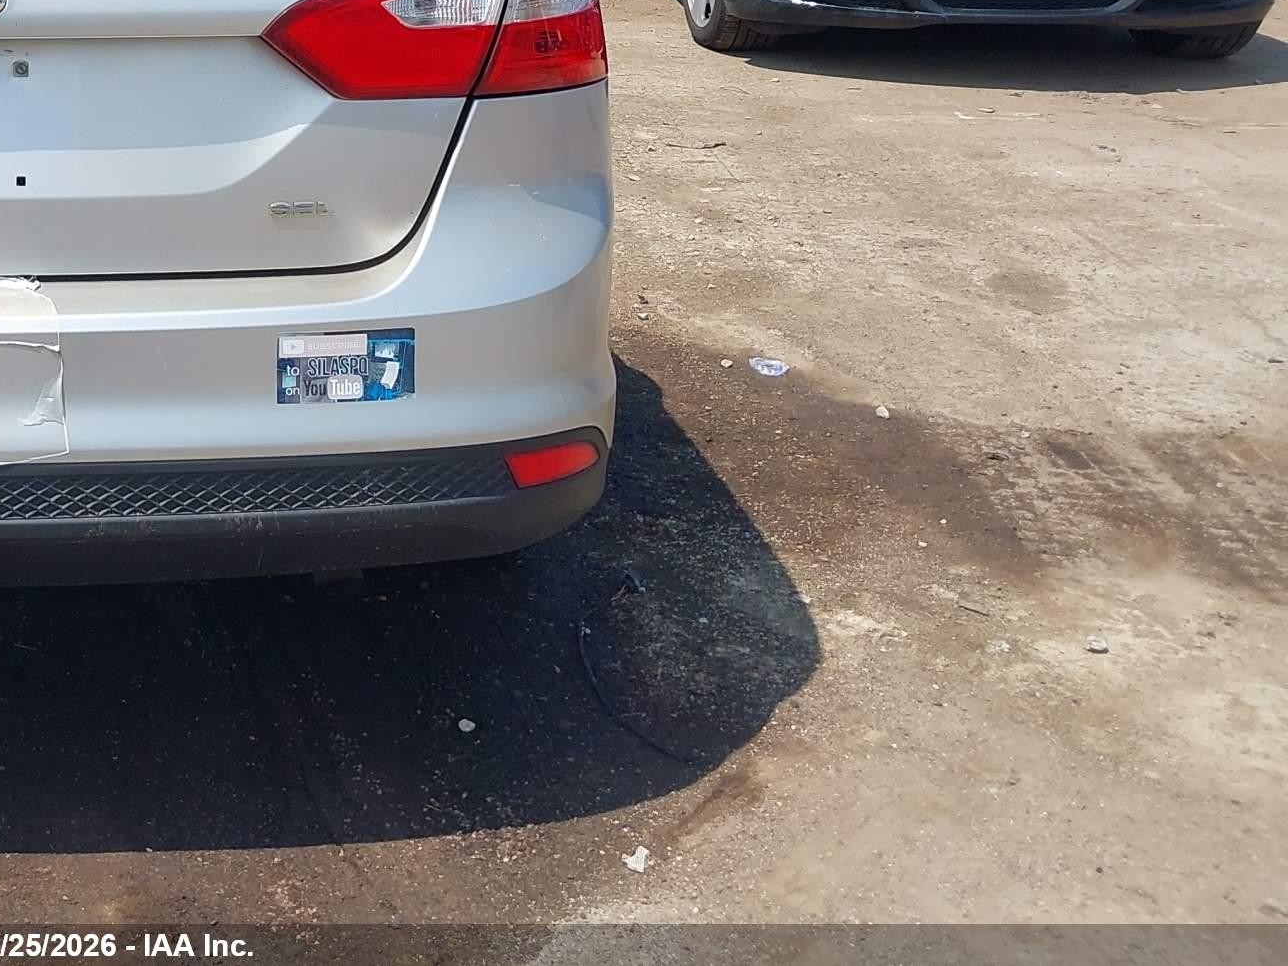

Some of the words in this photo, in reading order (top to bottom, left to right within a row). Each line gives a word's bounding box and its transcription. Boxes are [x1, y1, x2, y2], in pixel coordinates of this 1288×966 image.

[306, 340, 359, 351] SUBSCRIBE
[286, 365, 300, 376] to
[285, 387, 300, 396] on
[304, 378, 362, 397] YouTube
